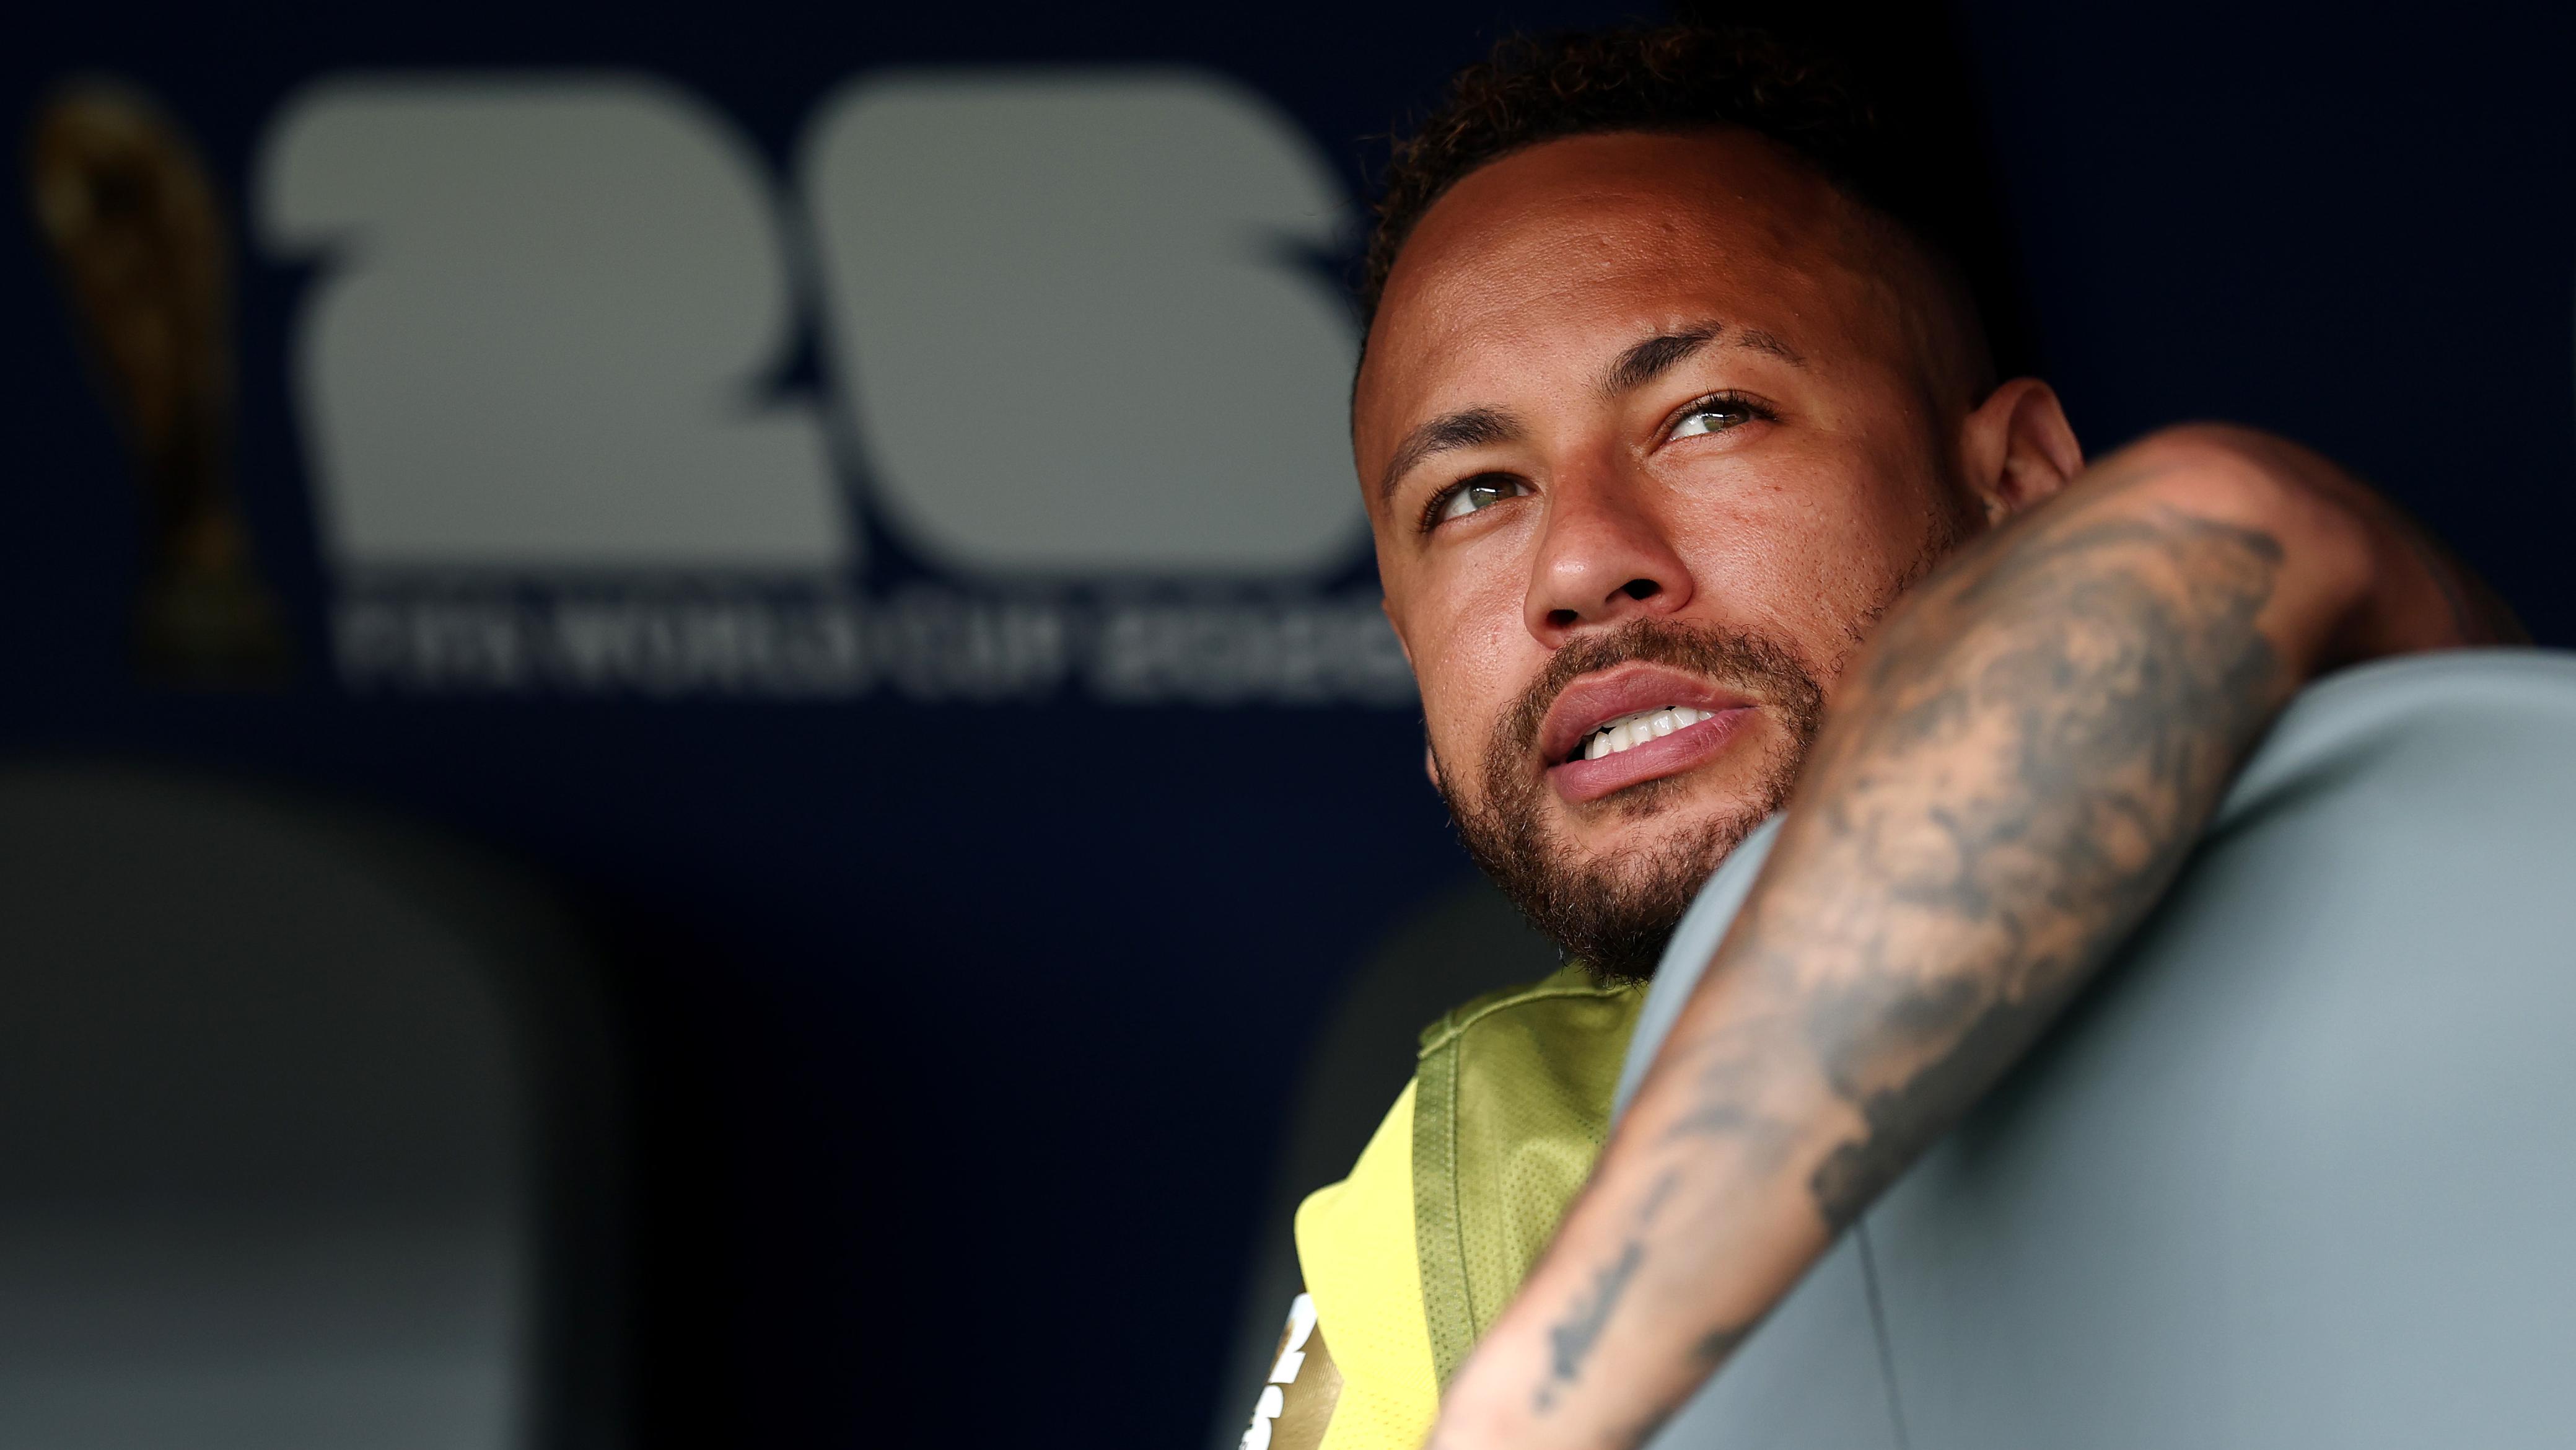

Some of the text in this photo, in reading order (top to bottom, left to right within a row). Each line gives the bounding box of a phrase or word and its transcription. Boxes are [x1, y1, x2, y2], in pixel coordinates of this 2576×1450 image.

[255, 68, 1374, 576] 26
[333, 597, 524, 695] FIFA
[546, 597, 869, 699] WORLD
[886, 597, 1068, 700] CUP
